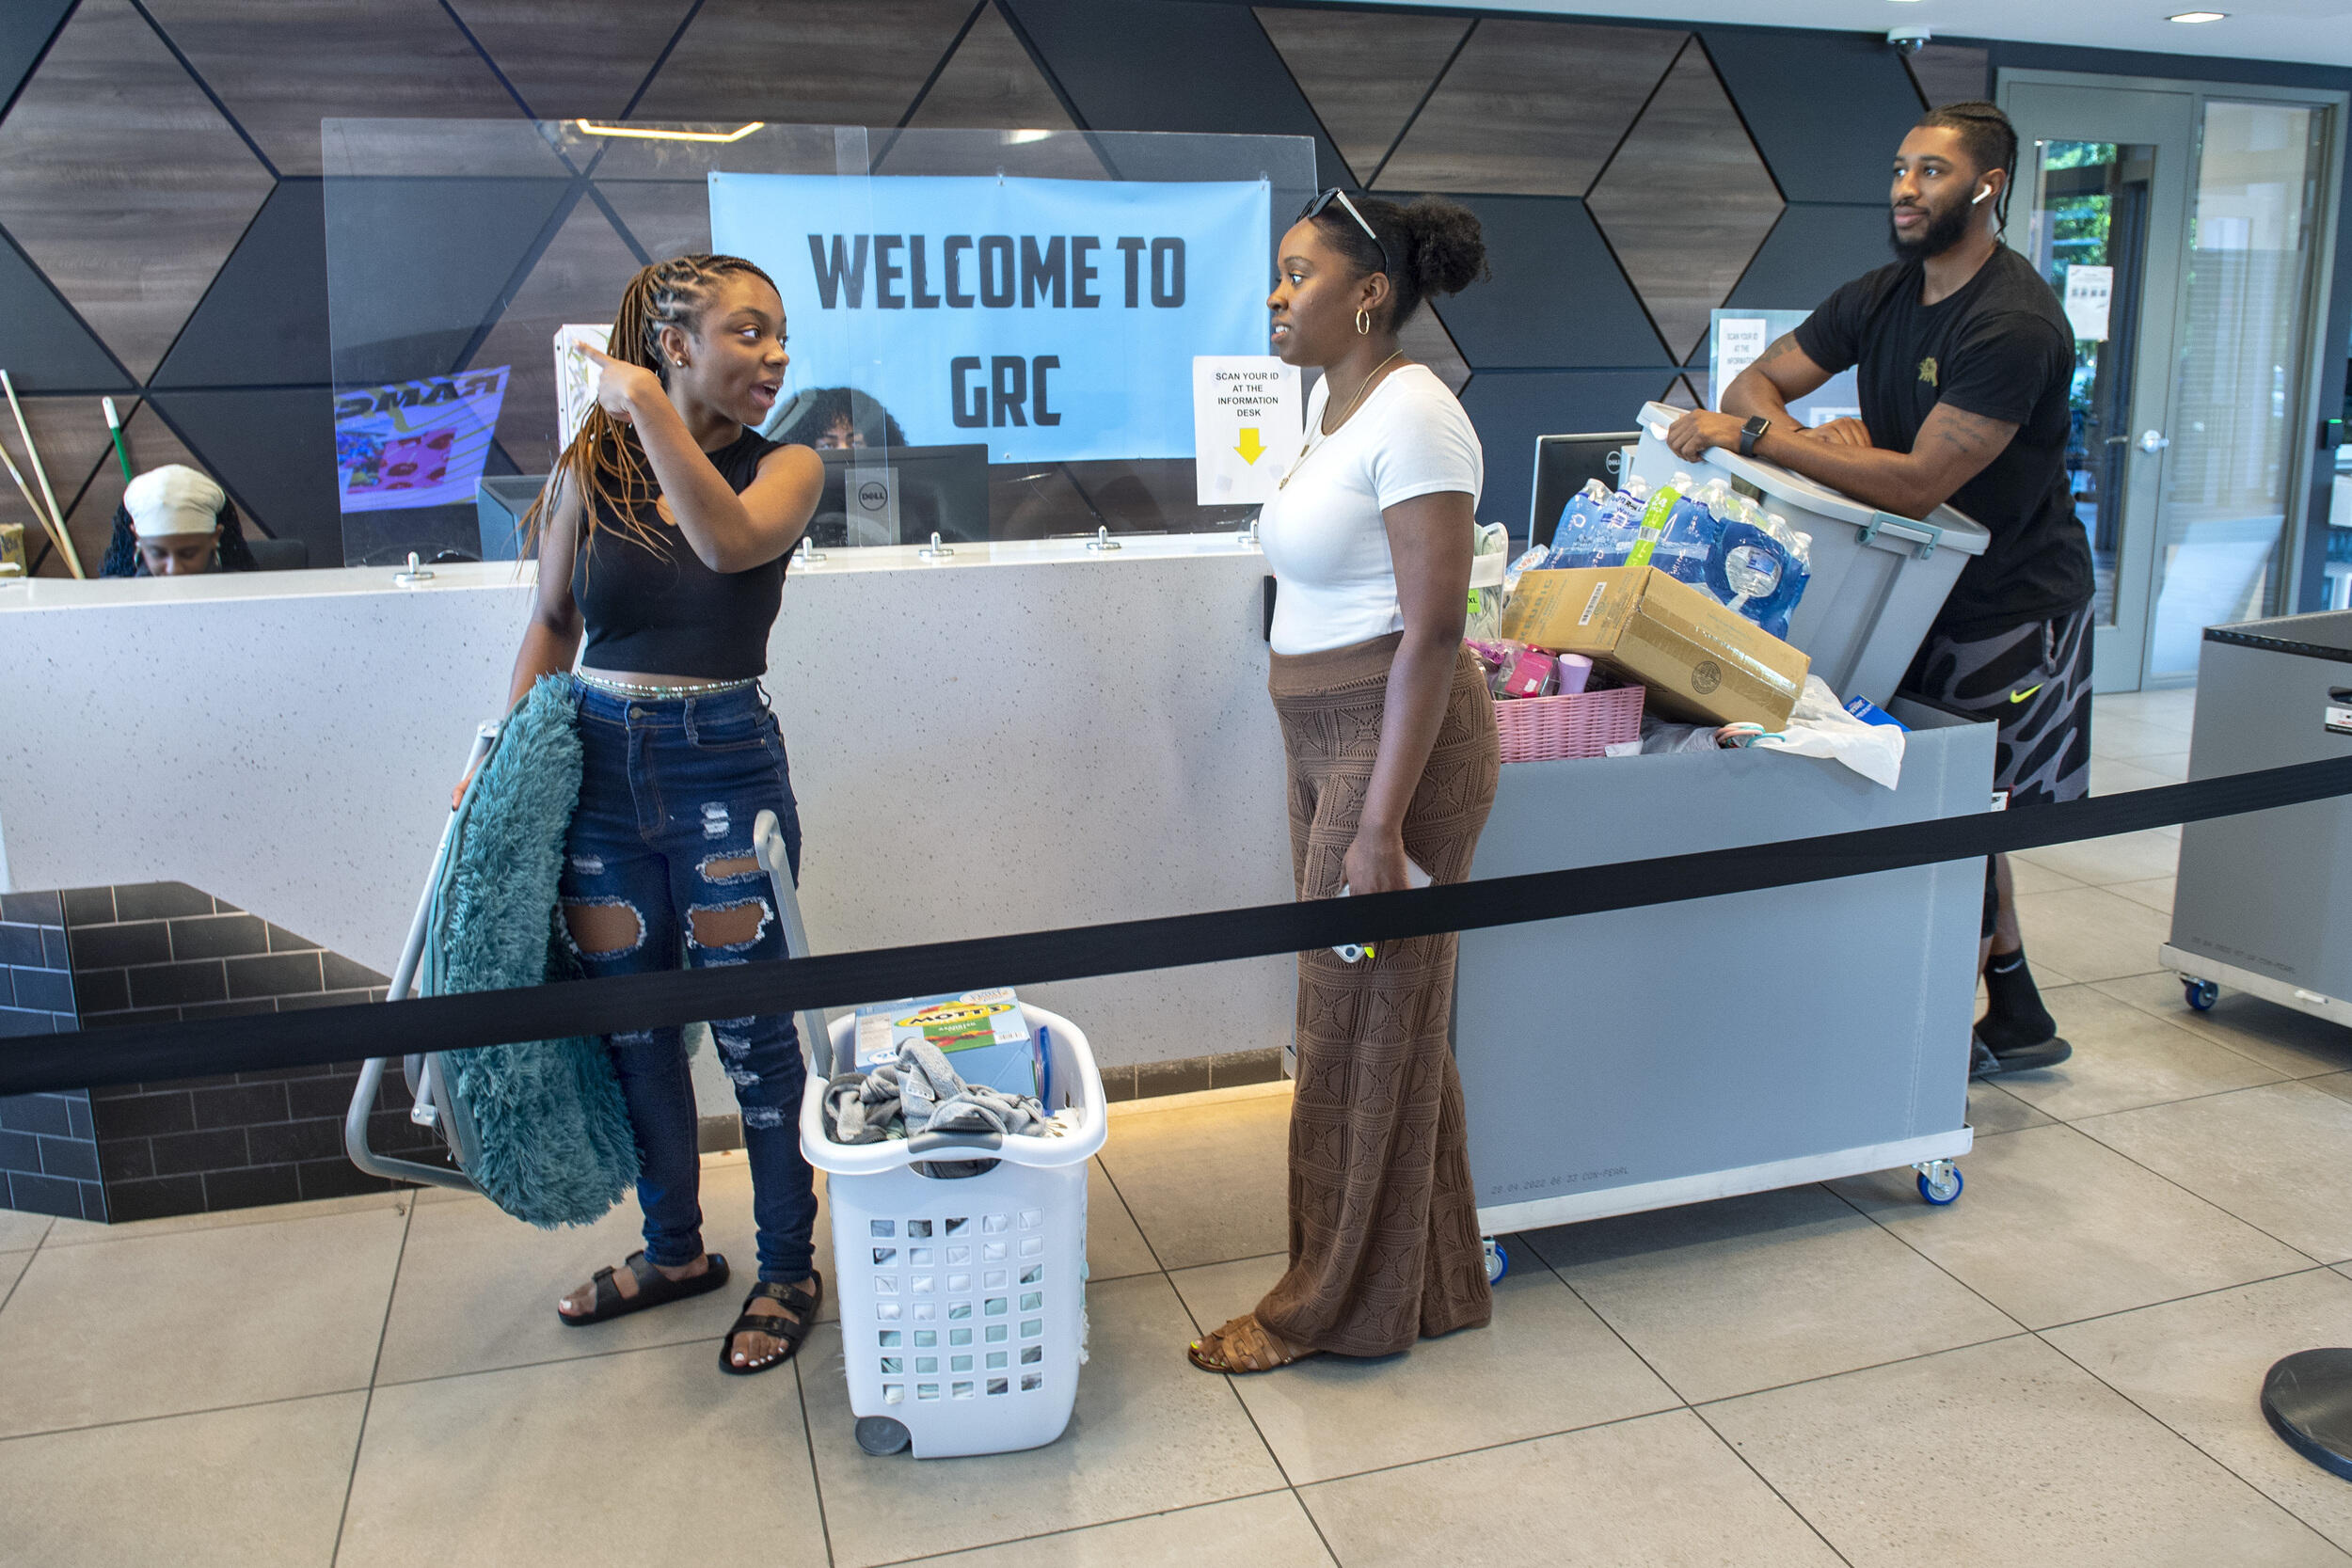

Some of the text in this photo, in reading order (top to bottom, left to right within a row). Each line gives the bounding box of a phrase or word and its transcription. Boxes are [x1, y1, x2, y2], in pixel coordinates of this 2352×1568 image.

[807, 233, 1186, 309] WELCOME TO
[950, 356, 1062, 428] GRC
[1216, 372, 1279, 381] SCAN YOUR ID
[862, 492, 884, 500] DELL
